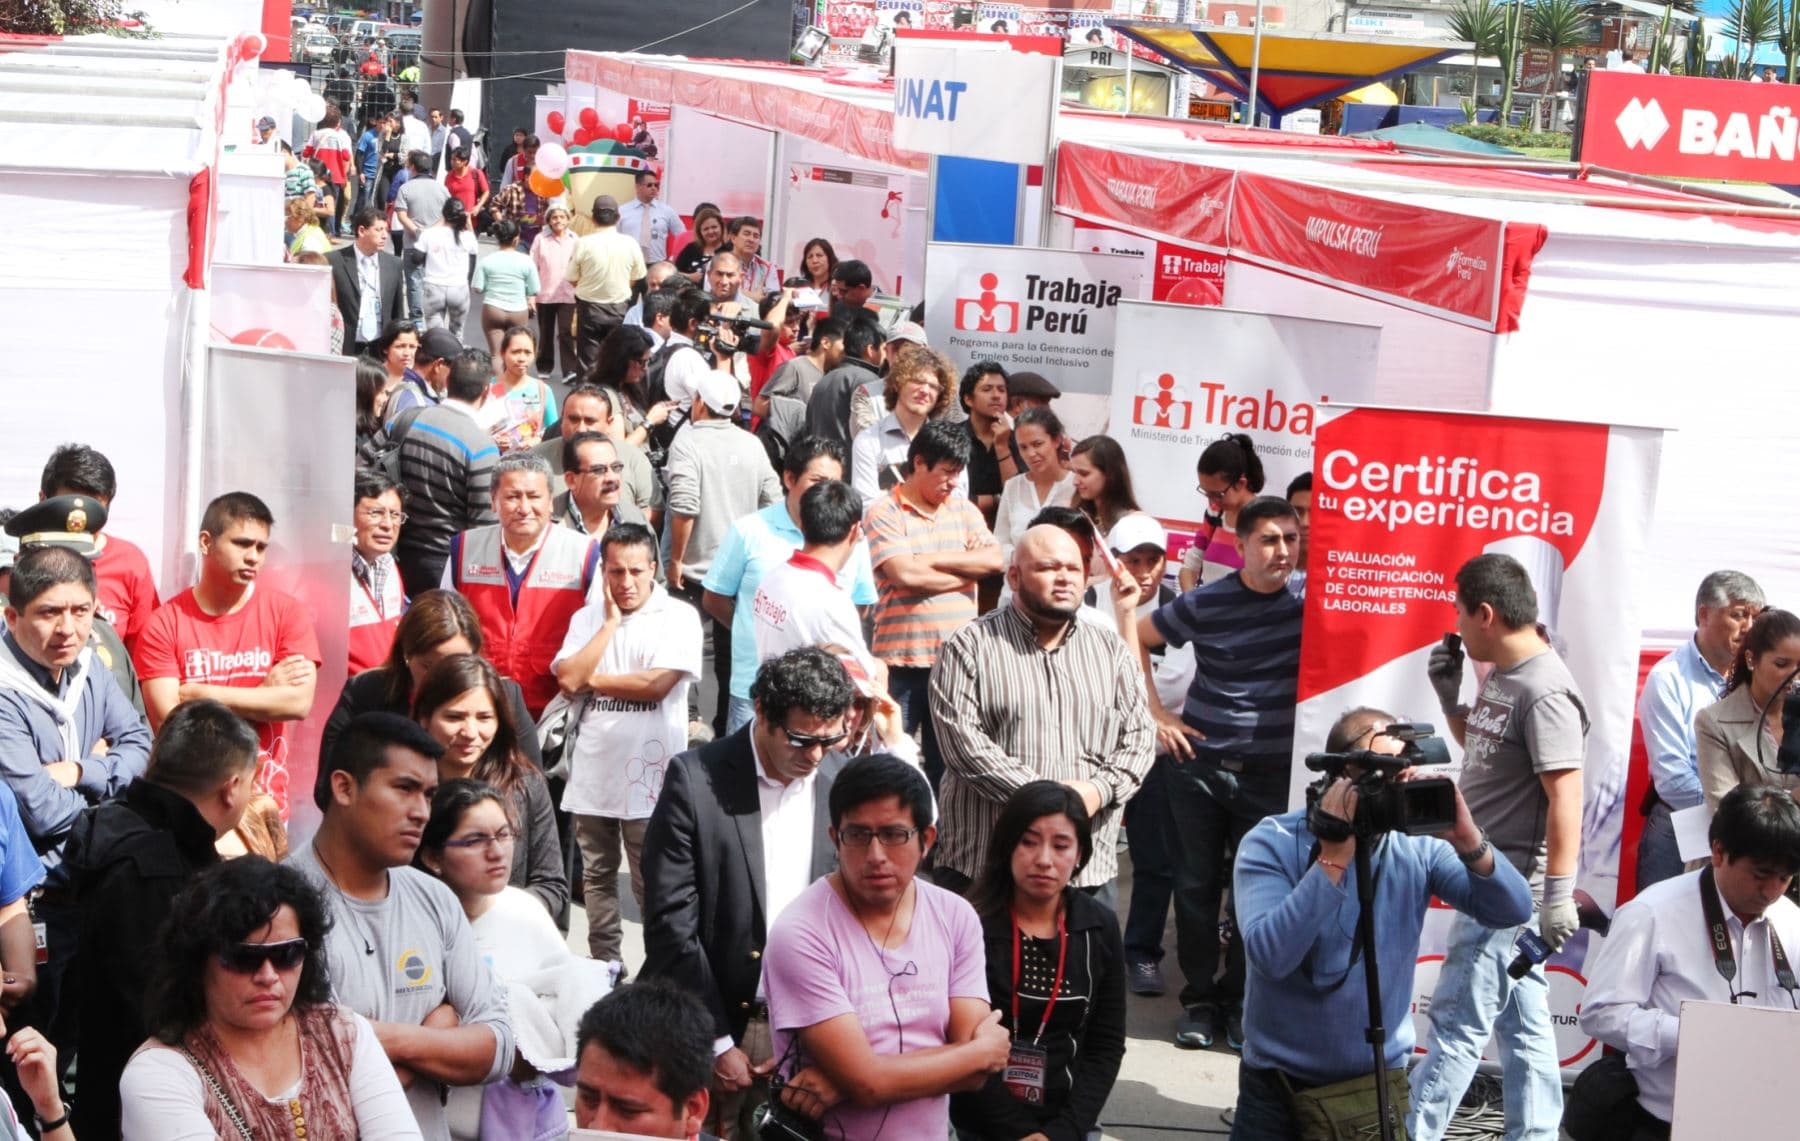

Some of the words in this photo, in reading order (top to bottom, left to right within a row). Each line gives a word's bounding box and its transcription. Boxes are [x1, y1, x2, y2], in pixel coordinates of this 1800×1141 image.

[877, 0, 923, 11] PUNO
[1069, 18, 1105, 28] PUN
[1090, 51, 1112, 66] PRI
[1678, 106, 1800, 161] BAÑ
[1305, 216, 1349, 250] IMPULSA
[1350, 225, 1384, 259] PERÚ
[1025, 274, 1122, 308] Trabaja
[1025, 305, 1088, 335] Perú
[950, 336, 999, 350] Programa
[1001, 342, 1025, 353] para
[1027, 342, 1038, 352] la
[1040, 343, 1098, 357] Generación
[1100, 347, 1114, 358] de
[970, 351, 1009, 363] Empleo
[1012, 353, 1043, 365] Social
[1045, 356, 1090, 369] Inclusivo
[1200, 382, 1328, 442] Traba
[1131, 428, 1178, 444] Ministerio
[1180, 433, 1193, 446] de
[1294, 448, 1311, 460] del
[1321, 449, 1541, 503] Certifica
[1318, 492, 1338, 510] tu
[1343, 496, 1574, 536] experiencia
[1327, 550, 1416, 567] EVALUACIÓN
[1326, 566, 1335, 578] Y
[1337, 567, 1445, 585] CERTIFICACIÓN
[1324, 582, 1345, 595] DE
[1347, 584, 1457, 602] COMPETENCIAS
[1323, 598, 1407, 615] LABORALES
[211, 646, 271, 673] Trabajo
[1713, 923, 1727, 951] EOS
[1551, 1014, 1578, 1026] TUR
